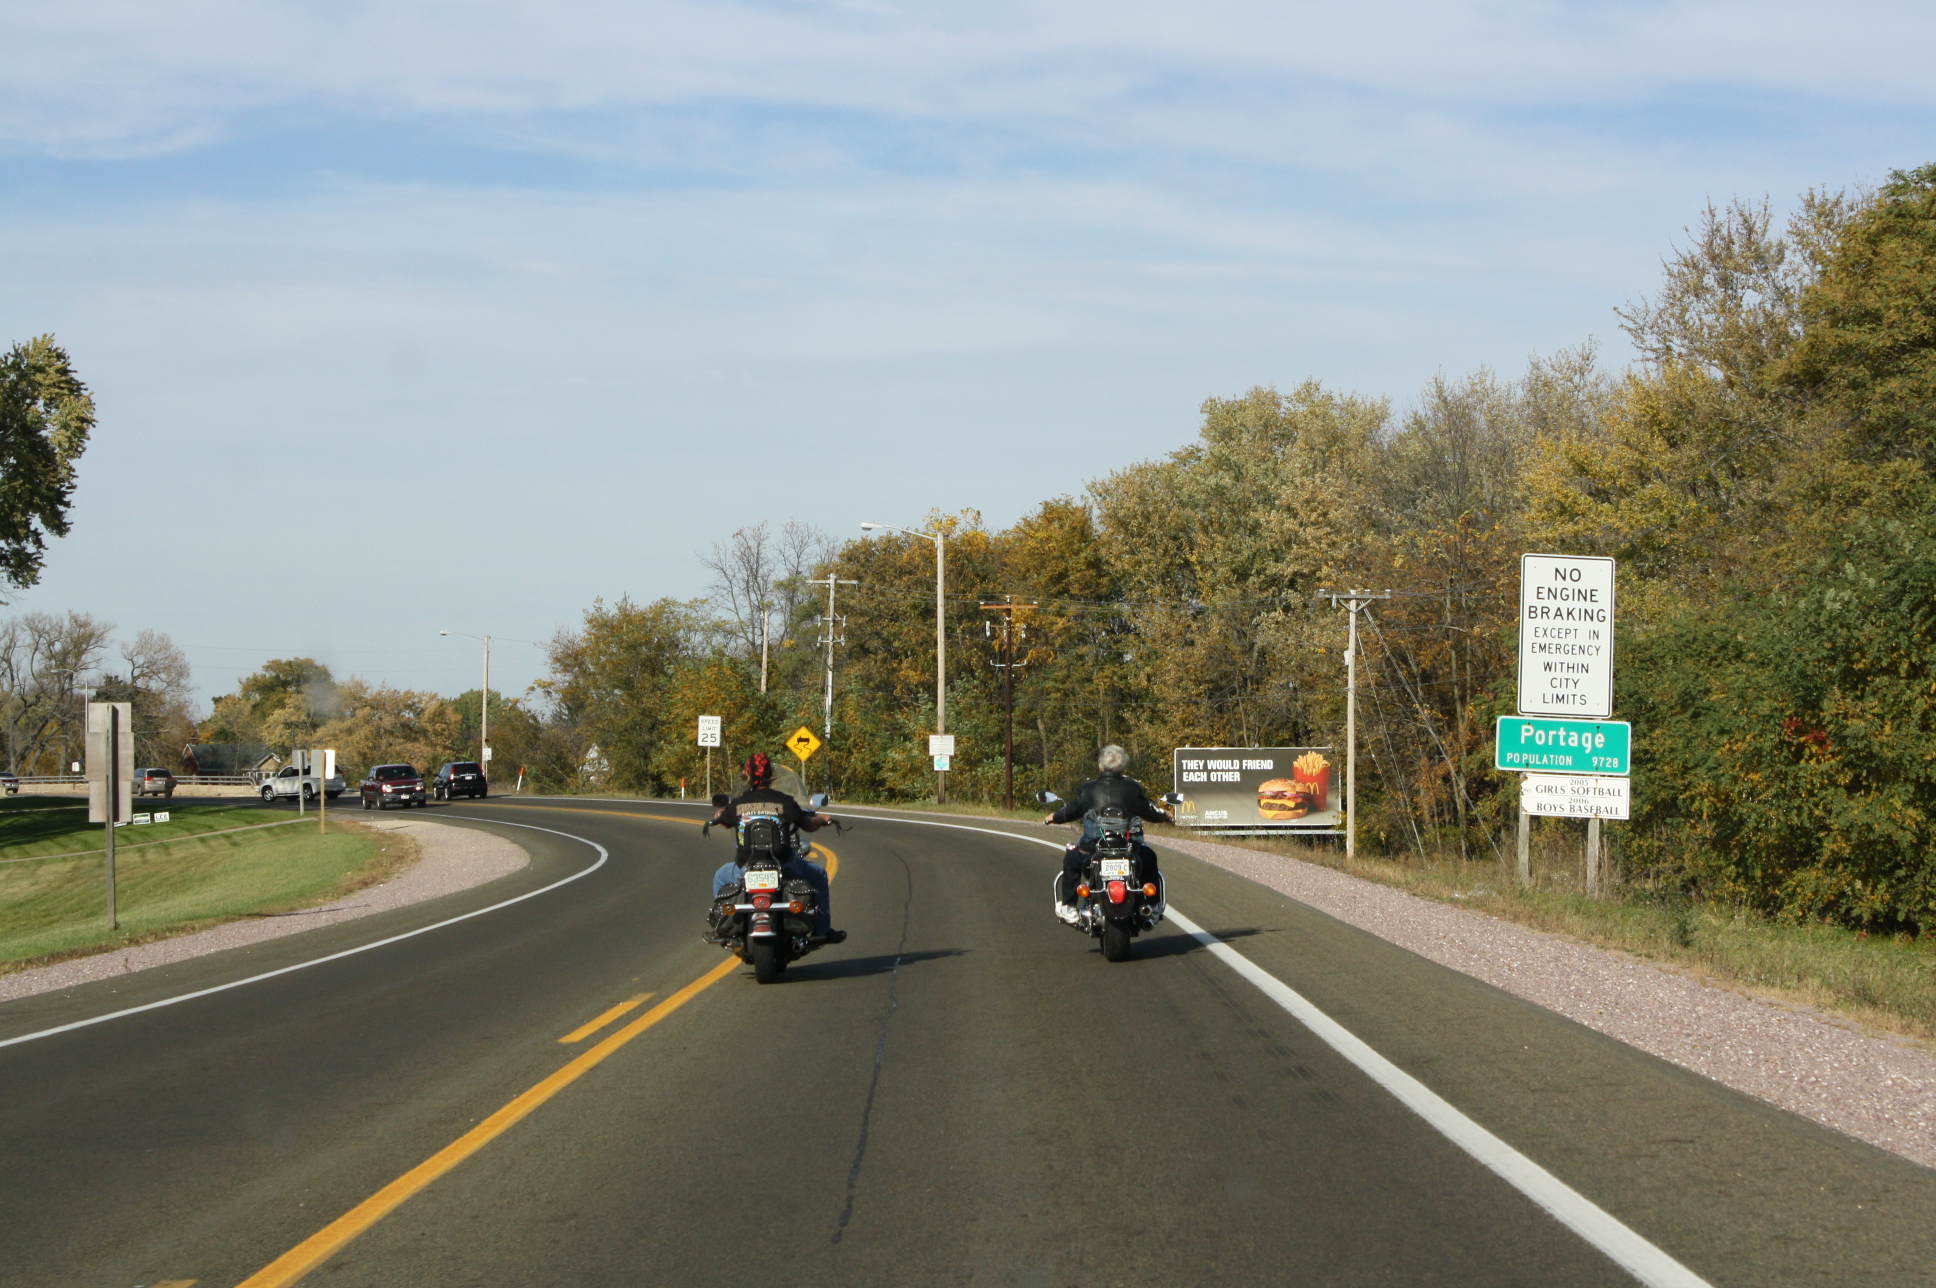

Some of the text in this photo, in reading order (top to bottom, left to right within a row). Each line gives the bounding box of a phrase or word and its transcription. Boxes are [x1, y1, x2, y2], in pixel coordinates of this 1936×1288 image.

[1554, 567, 1582, 582] NO
[1536, 586, 1599, 602] ENGINE
[1528, 605, 1606, 622] BRAKING
[1534, 626, 1600, 640] EXCEPT IN
[1531, 642, 1601, 656] EMERGENCY
[1543, 661, 1589, 674] WITHIN
[1550, 677, 1580, 689] CITY
[1542, 692, 1587, 706] LIMITS
[701, 733, 717, 743] 25
[1520, 724, 1605, 754] Portage
[1182, 759, 1274, 770] THEY WOULD FRIEND
[1506, 752, 1619, 769] POPULATION 9728
[1182, 771, 1241, 782] EACH OTHER
[1535, 784, 1566, 795] GIRLS
[1570, 786, 1623, 798] SOFTBALL
[1568, 797, 1589, 805] 2006
[1536, 803, 1621, 816] BOYS BASEBALL
[747, 873, 776, 882] 63545
